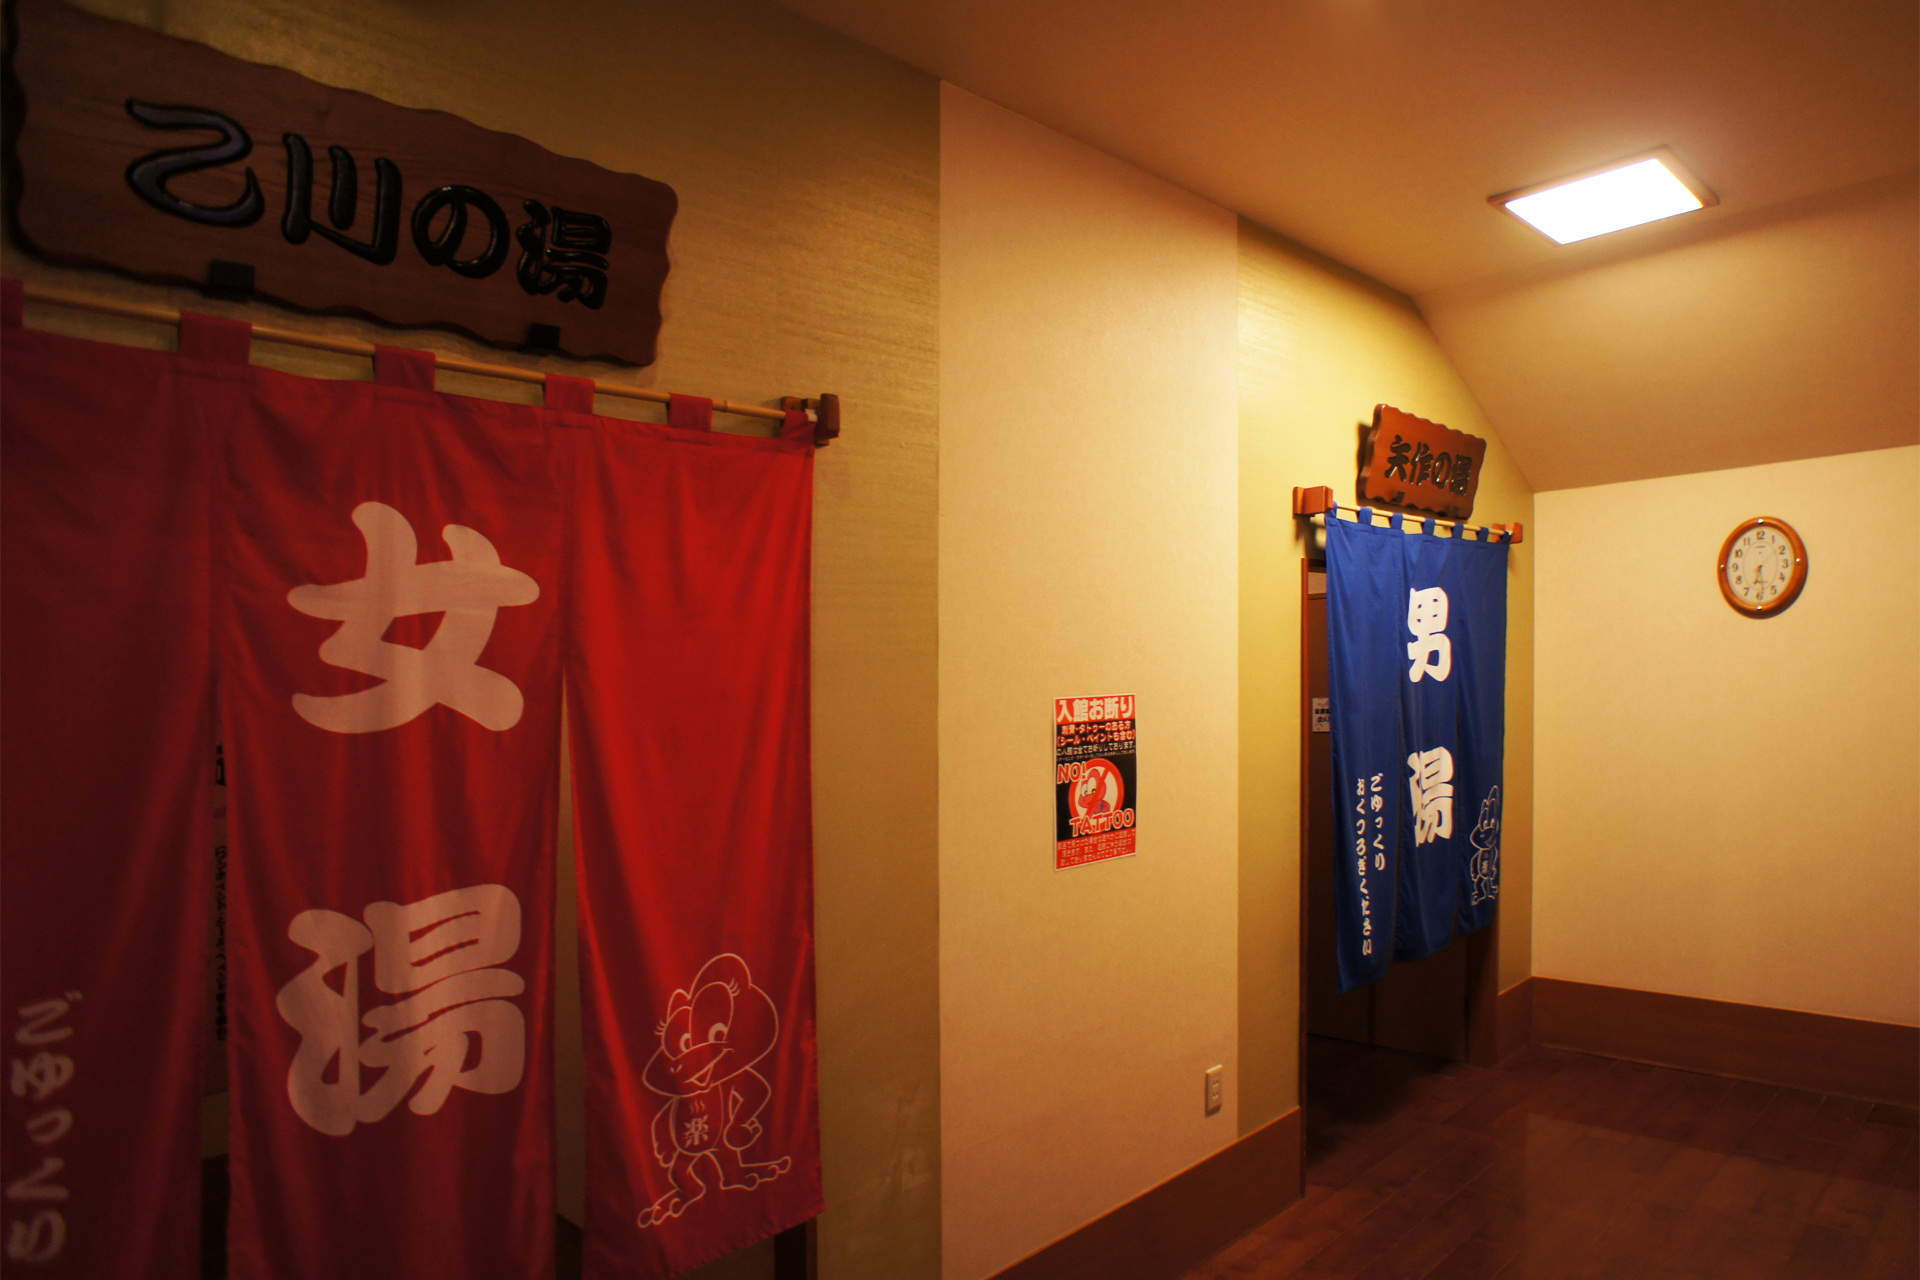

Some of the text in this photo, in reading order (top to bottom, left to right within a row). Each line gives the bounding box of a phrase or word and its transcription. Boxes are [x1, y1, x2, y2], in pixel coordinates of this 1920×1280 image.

[1756, 530, 1765, 540] 12
[1743, 537, 1751, 546] 11
[1734, 548, 1743, 559] 10
[1778, 545, 1786, 555] 2
[1731, 562, 1739, 572] 9
[1782, 558, 1789, 569] 3
[1735, 575, 1742, 585] 8
[1778, 572, 1786, 582] 4
[1743, 587, 1750, 597] 7
[1756, 591, 1763, 600] 6
[1770, 585, 1777, 595] 5
[1057, 696, 1133, 723] 入館お断り
[1407, 586, 1454, 848] 男湯
[1057, 760, 1087, 784] NO!
[275, 500, 541, 1137] 女湯
[1069, 808, 1135, 837] TATTOO
[1370, 772, 1386, 871] ごゆっくり
[1356, 778, 1373, 956] おくつろぎください
[5, 988, 84, 1264] ごゆっくり
[683, 1114, 710, 1148] 楽
